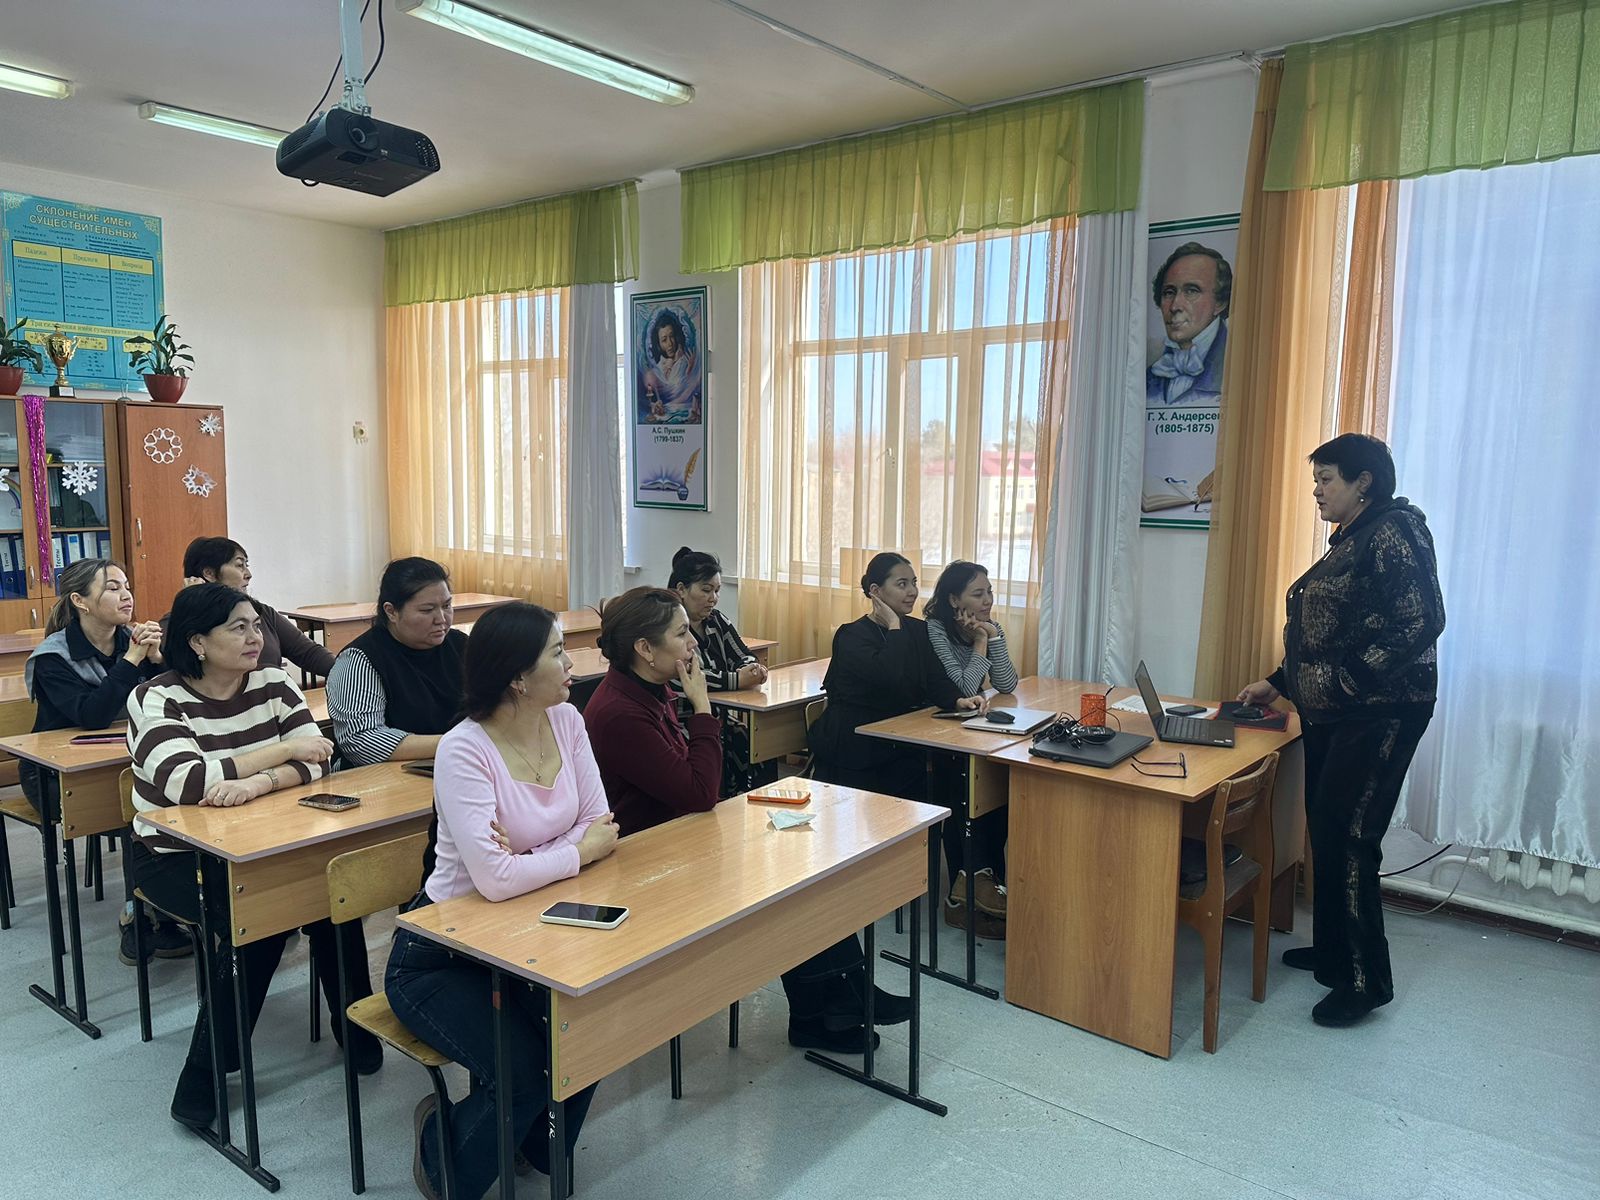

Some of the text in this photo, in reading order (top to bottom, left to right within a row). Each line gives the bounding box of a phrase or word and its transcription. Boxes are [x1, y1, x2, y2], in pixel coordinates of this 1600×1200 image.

[36, 204, 100, 222] СКЛОНЕНИЕ
[29, 214, 138, 239] СУЩЕСТВИТЕЛЬНЫХ
[1148, 412, 1155, 421] Г.
[1158, 412, 1168, 421] Х.
[1155, 424, 1214, 435] (1805-1875)
